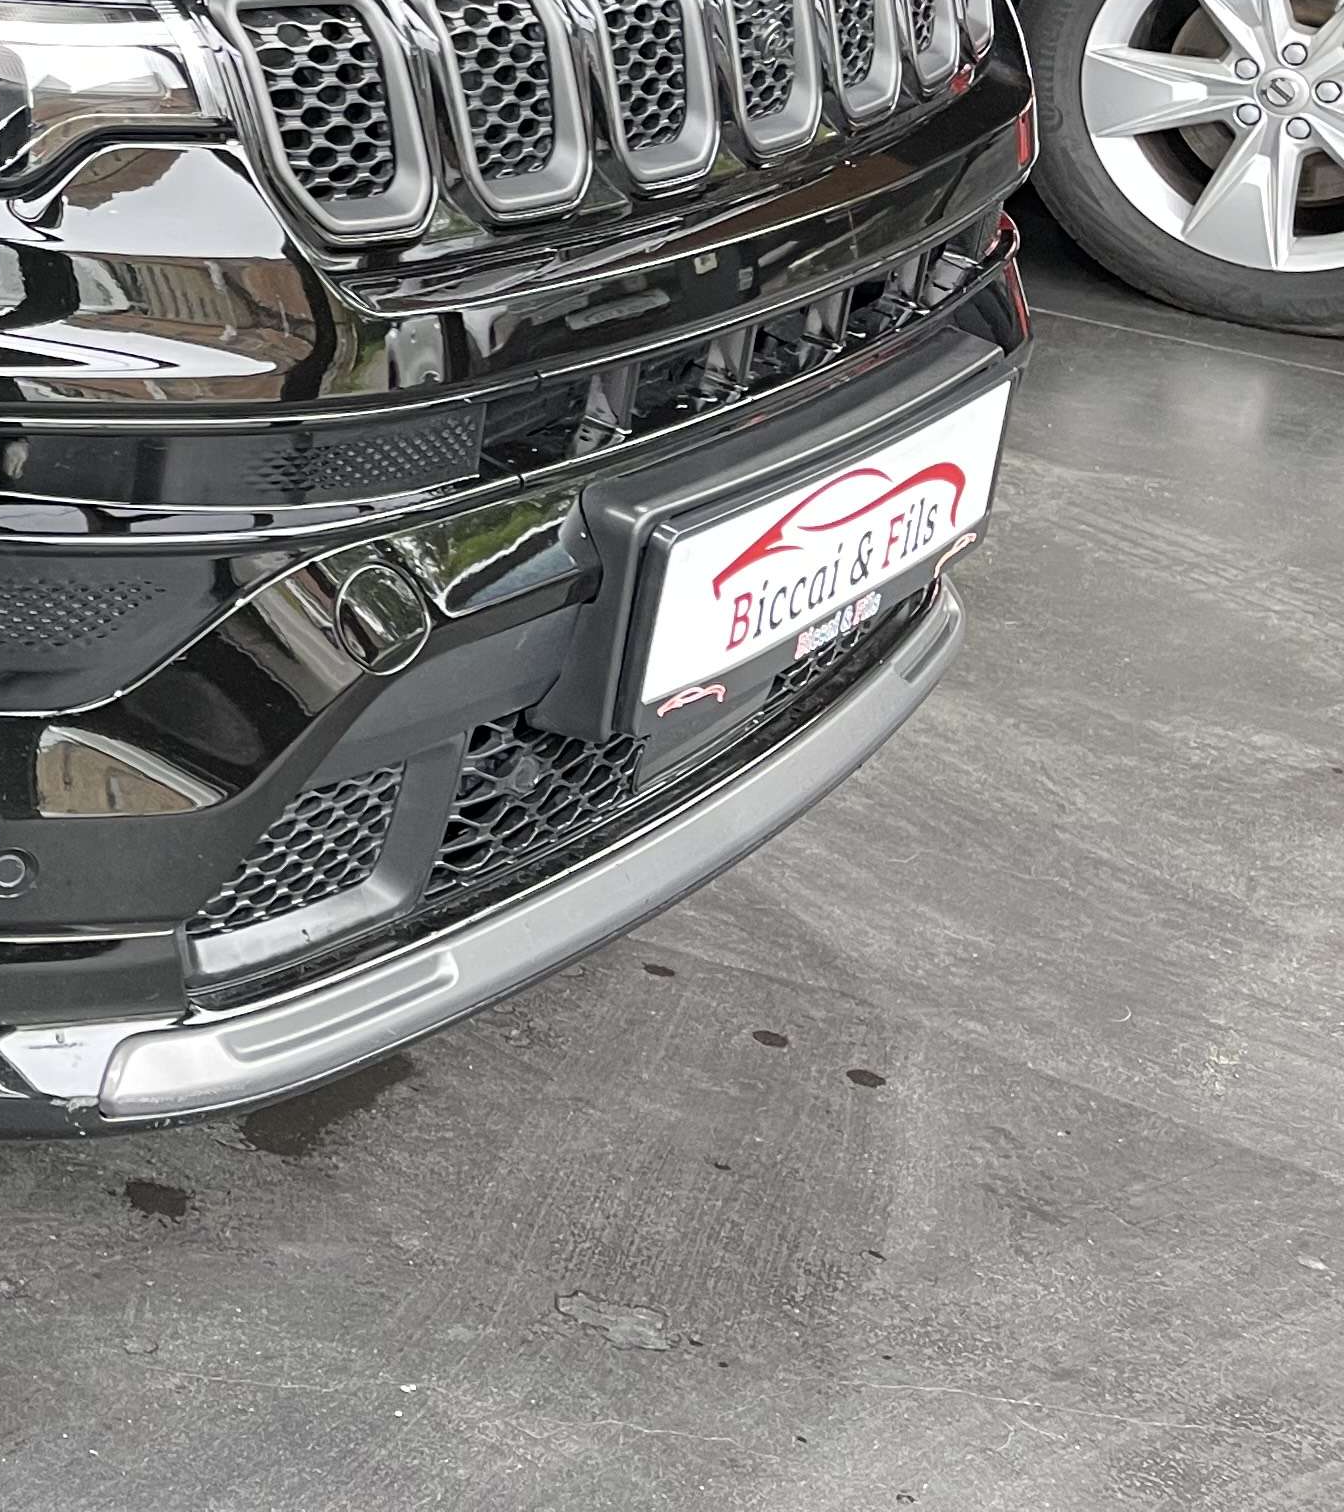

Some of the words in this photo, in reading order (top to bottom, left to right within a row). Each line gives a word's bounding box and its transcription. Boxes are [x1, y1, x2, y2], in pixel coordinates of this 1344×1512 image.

[726, 542, 843, 652] Biccai
[850, 531, 874, 585] &
[881, 498, 938, 569] Fils
